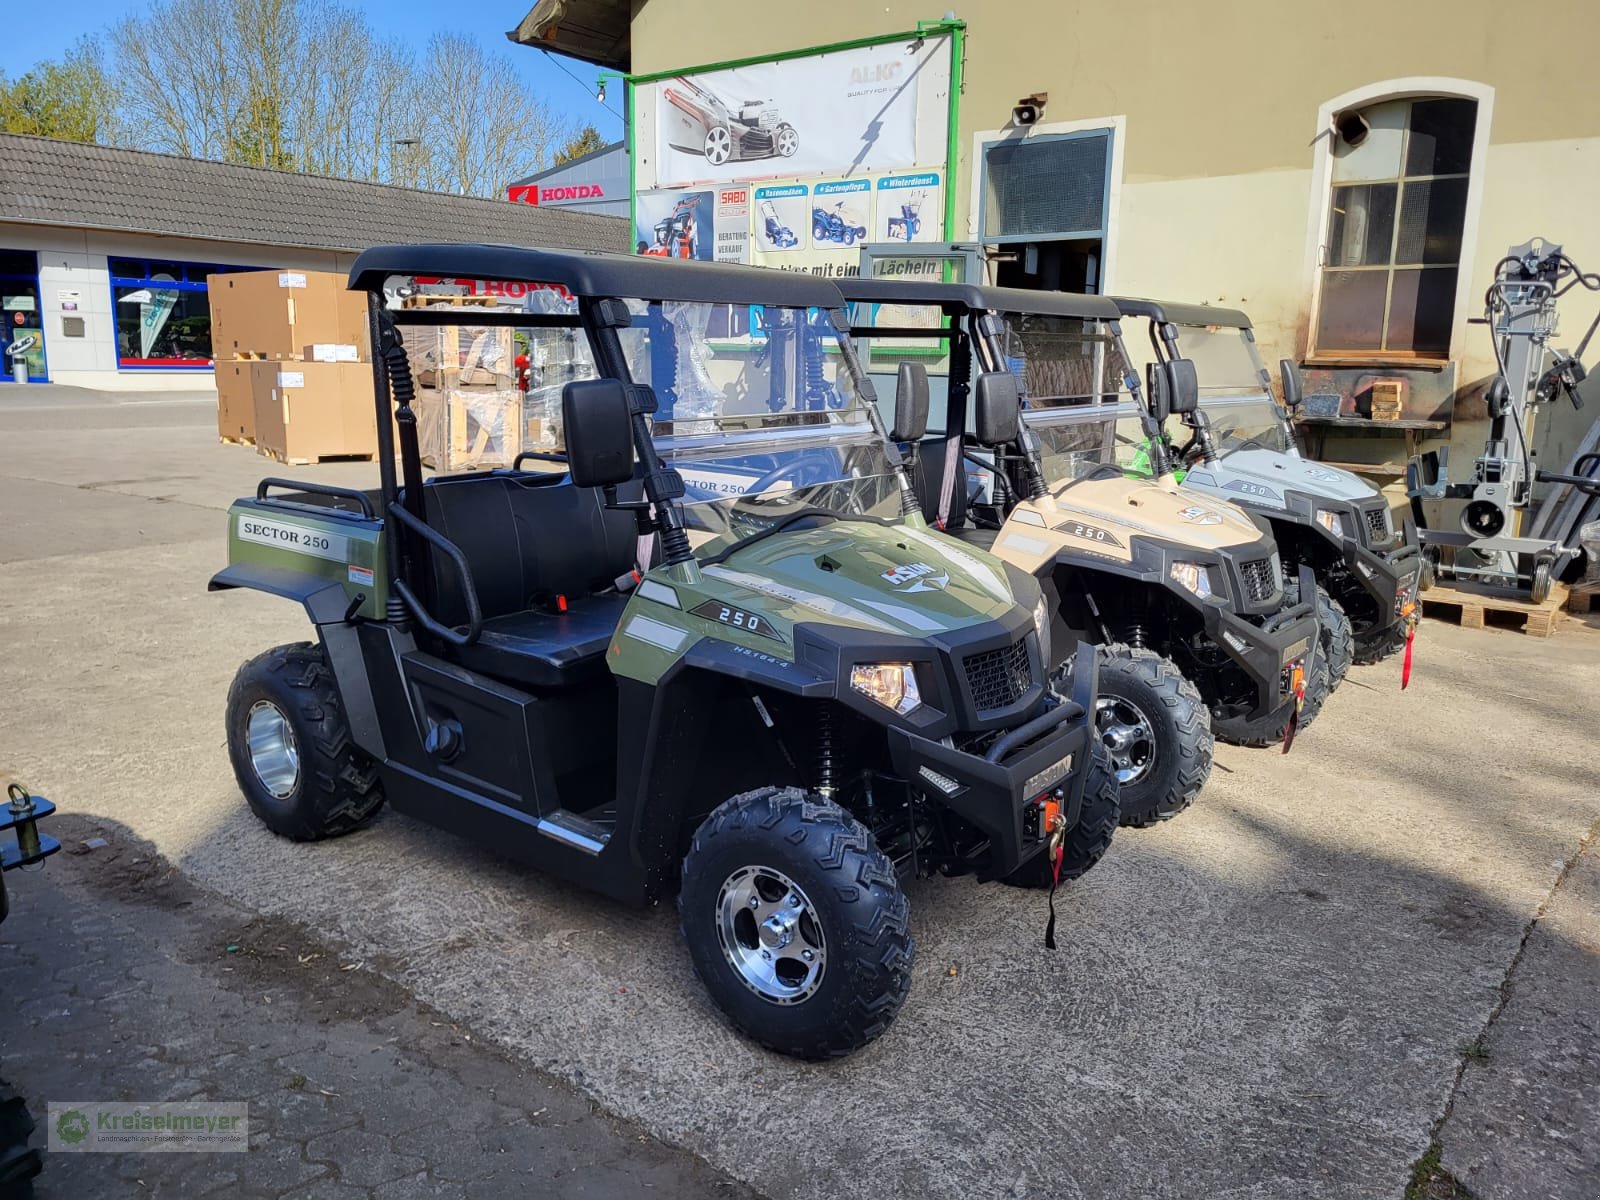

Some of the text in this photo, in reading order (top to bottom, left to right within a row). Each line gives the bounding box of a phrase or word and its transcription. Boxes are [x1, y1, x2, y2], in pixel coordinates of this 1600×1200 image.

[889, 175, 933, 187] Winterdienst
[541, 184, 604, 201] HONDA
[721, 191, 746, 204] SABO
[718, 232, 747, 241] BERATUNG
[718, 245, 743, 254] VERKAUF
[811, 263, 834, 278] mit
[879, 259, 937, 276] Lächeln
[721, 484, 745, 494] 250
[1241, 484, 1266, 495] 250
[244, 522, 330, 550] SECTOR 250
[1074, 525, 1105, 541] 250
[719, 607, 759, 630] 250
